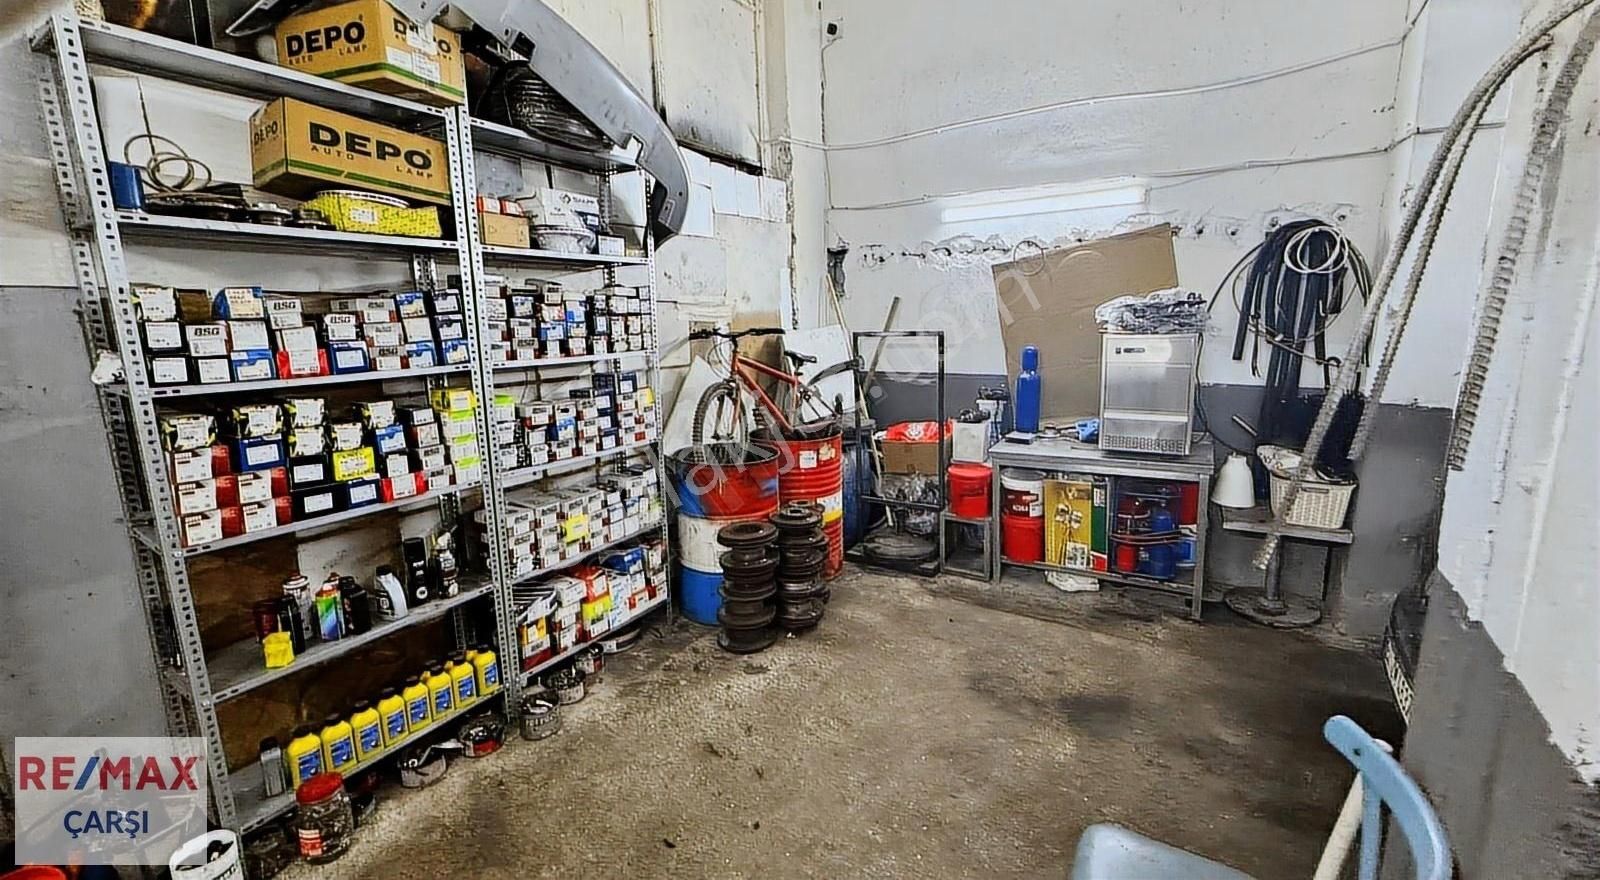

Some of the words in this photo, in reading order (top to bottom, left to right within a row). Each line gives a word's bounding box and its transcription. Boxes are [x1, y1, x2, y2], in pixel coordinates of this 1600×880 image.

[286, 21, 365, 58] DEPO
[339, 44, 367, 56] LAMP
[393, 17, 451, 54] DO
[253, 120, 278, 145] DEPO
[309, 121, 432, 170] DEPO
[311, 146, 354, 161] AUTO
[396, 166, 433, 179] LAMP
[273, 301, 297, 311] BSG
[194, 327, 220, 337] BSG
